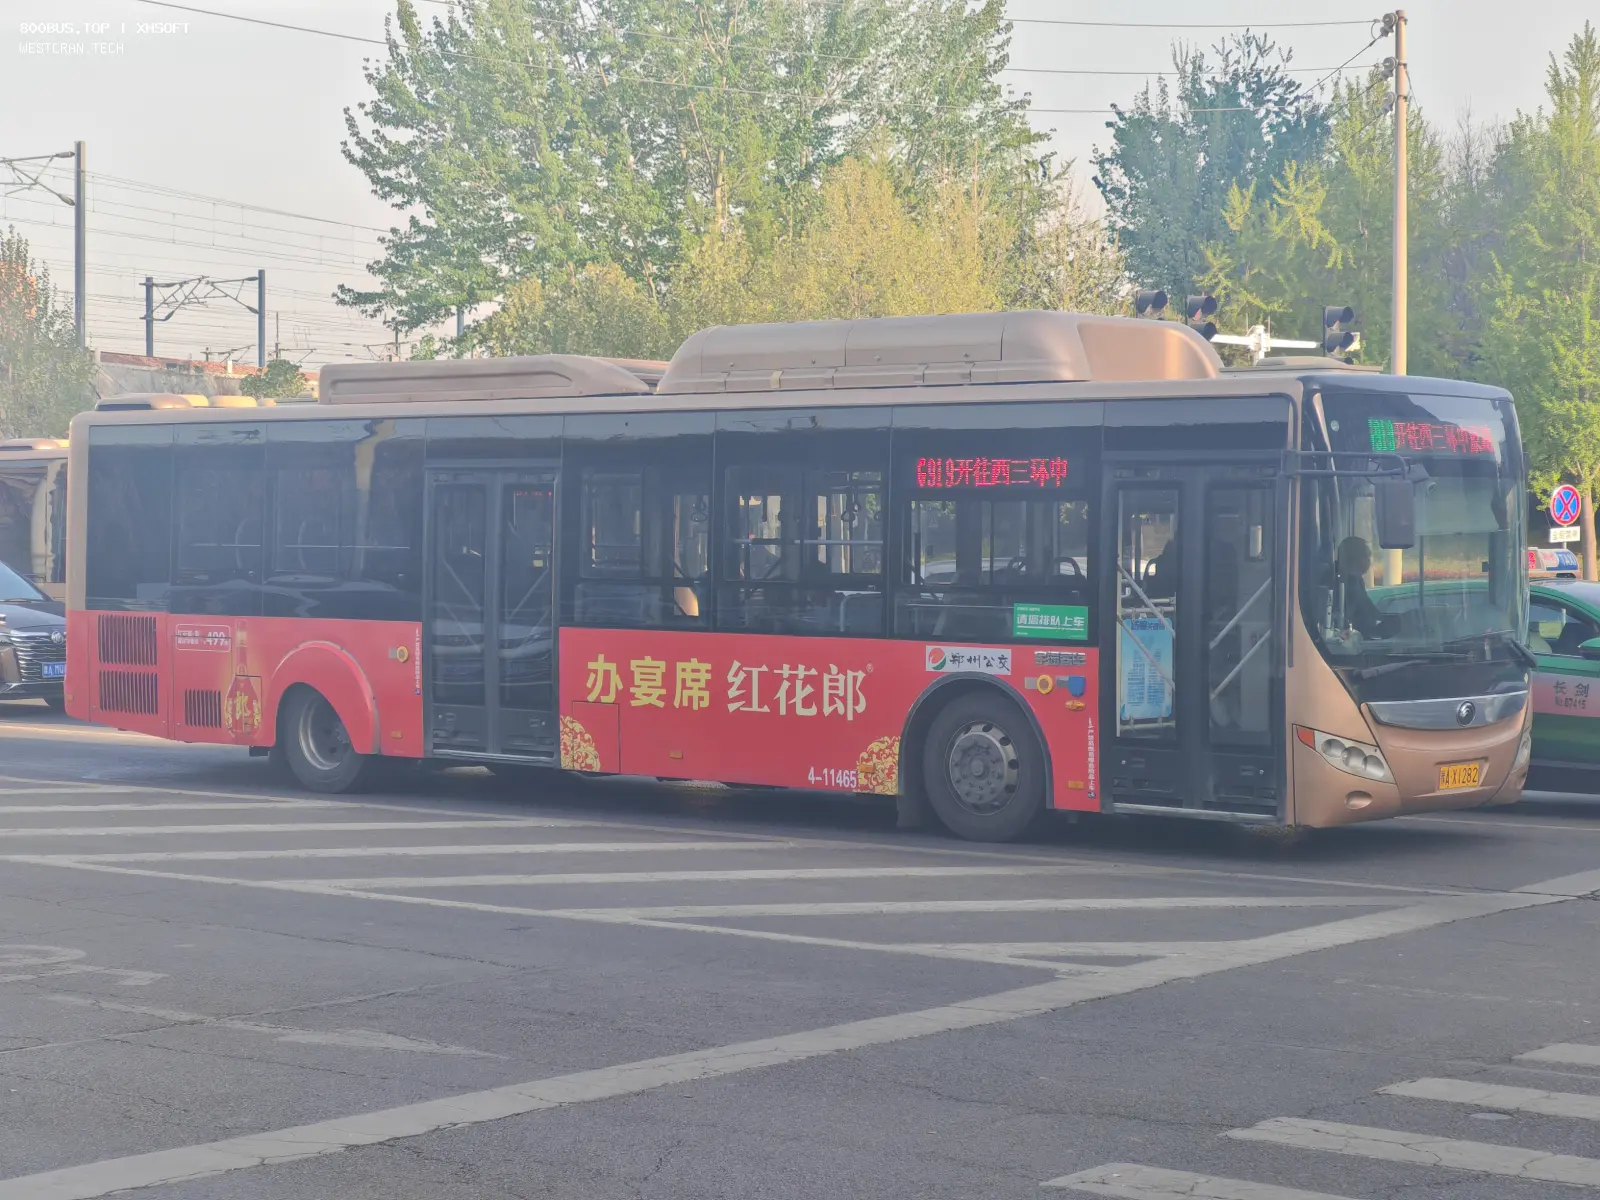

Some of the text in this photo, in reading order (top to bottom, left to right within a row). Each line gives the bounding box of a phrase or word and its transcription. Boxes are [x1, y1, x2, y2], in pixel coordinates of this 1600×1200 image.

[950, 652, 1010, 671] 郑州公交
[586, 654, 866, 721] 办宴席 红花郎
[807, 767, 857, 788] 4-11465
